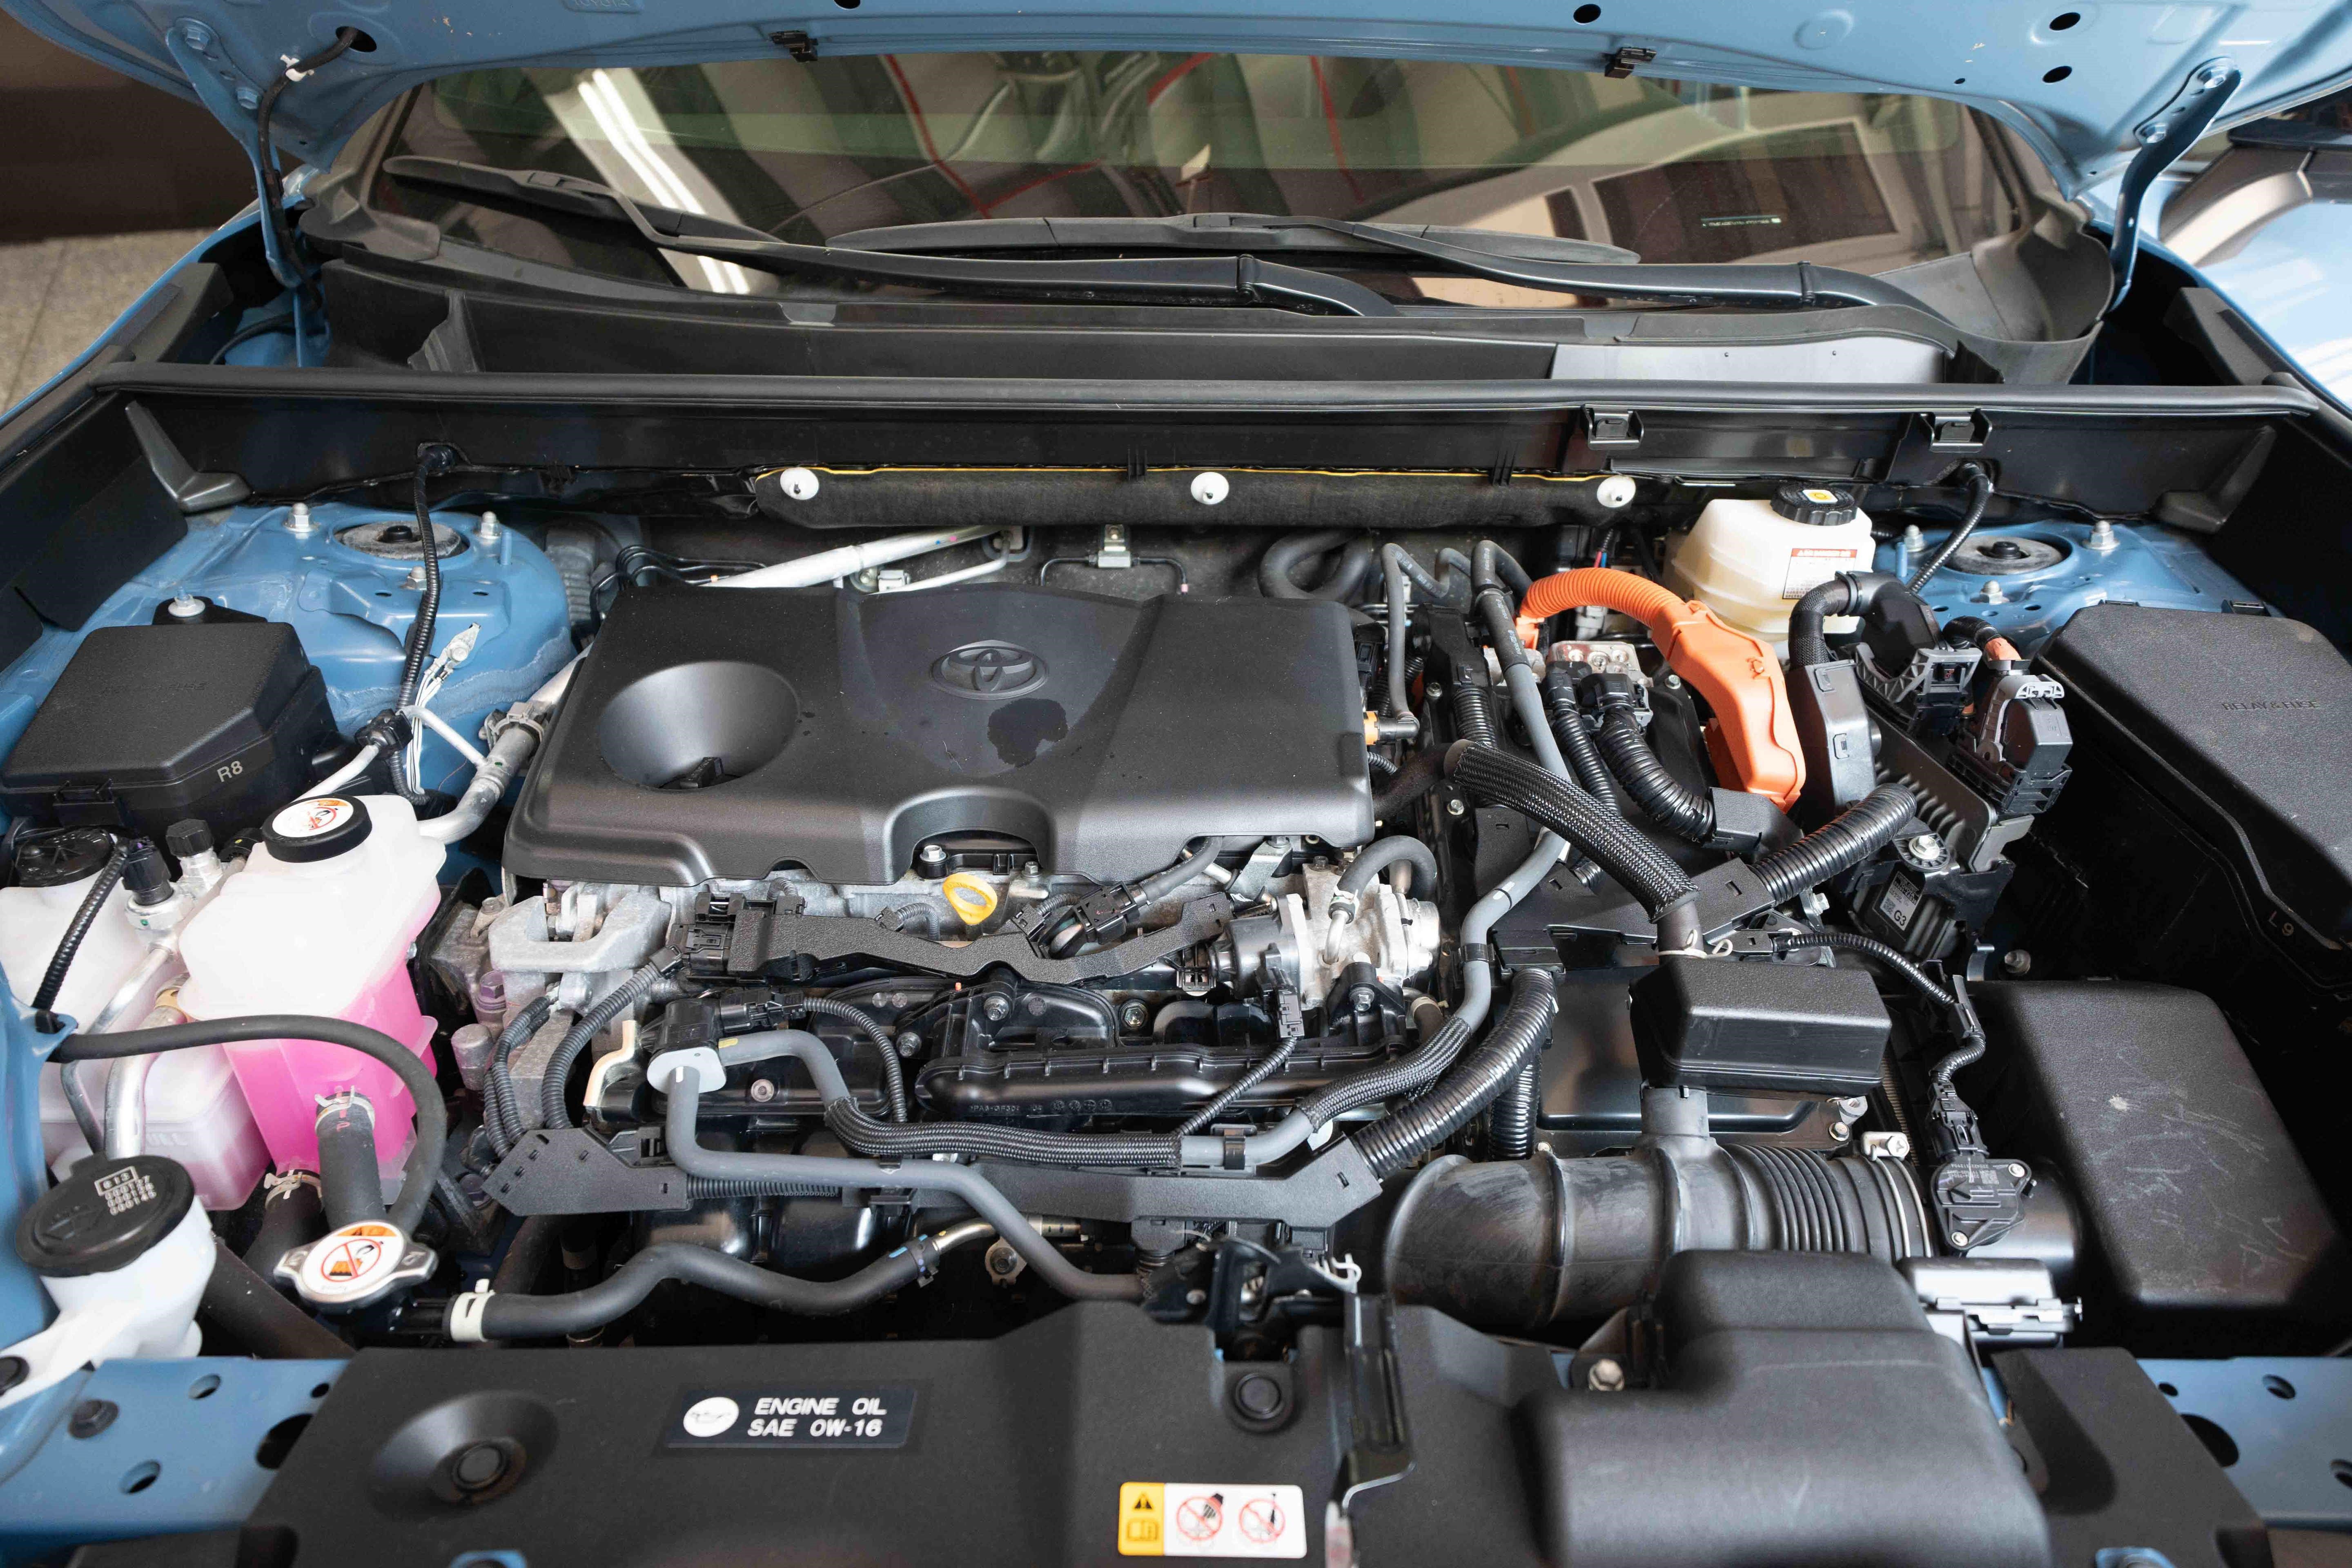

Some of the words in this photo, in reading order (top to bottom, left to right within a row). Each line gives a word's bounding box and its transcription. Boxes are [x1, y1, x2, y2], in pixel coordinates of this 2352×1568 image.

[217, 761, 243, 782] R8
[1894, 910, 1907, 926] G3
[754, 1397, 840, 1416] ENGINE
[852, 1397, 887, 1415] OIL
[747, 1418, 797, 1437] SAE
